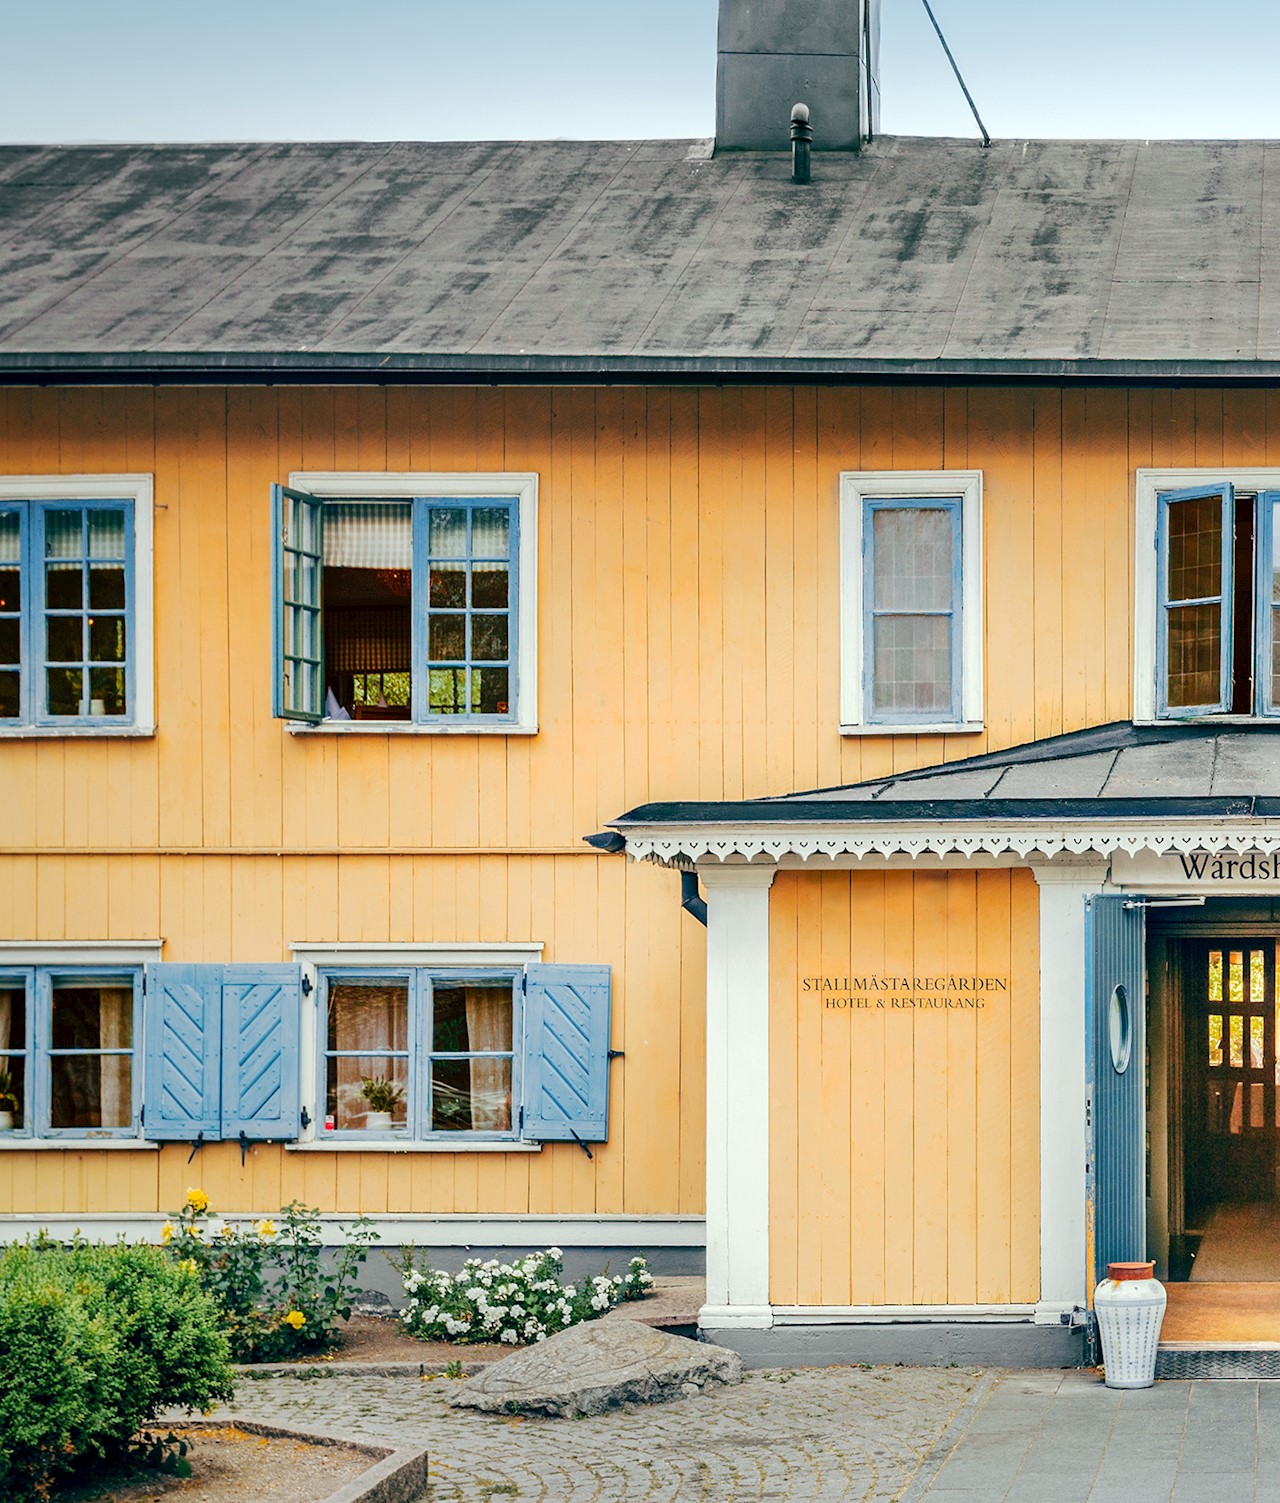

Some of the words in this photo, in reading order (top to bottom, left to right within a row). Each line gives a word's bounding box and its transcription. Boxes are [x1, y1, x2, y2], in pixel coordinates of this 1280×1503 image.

[802, 974, 1008, 991] STALLMÄSTAREGÅRDEN
[825, 998, 872, 1009] HOTEL
[876, 998, 885, 1009] &
[891, 998, 985, 1009] RESTAURANG
